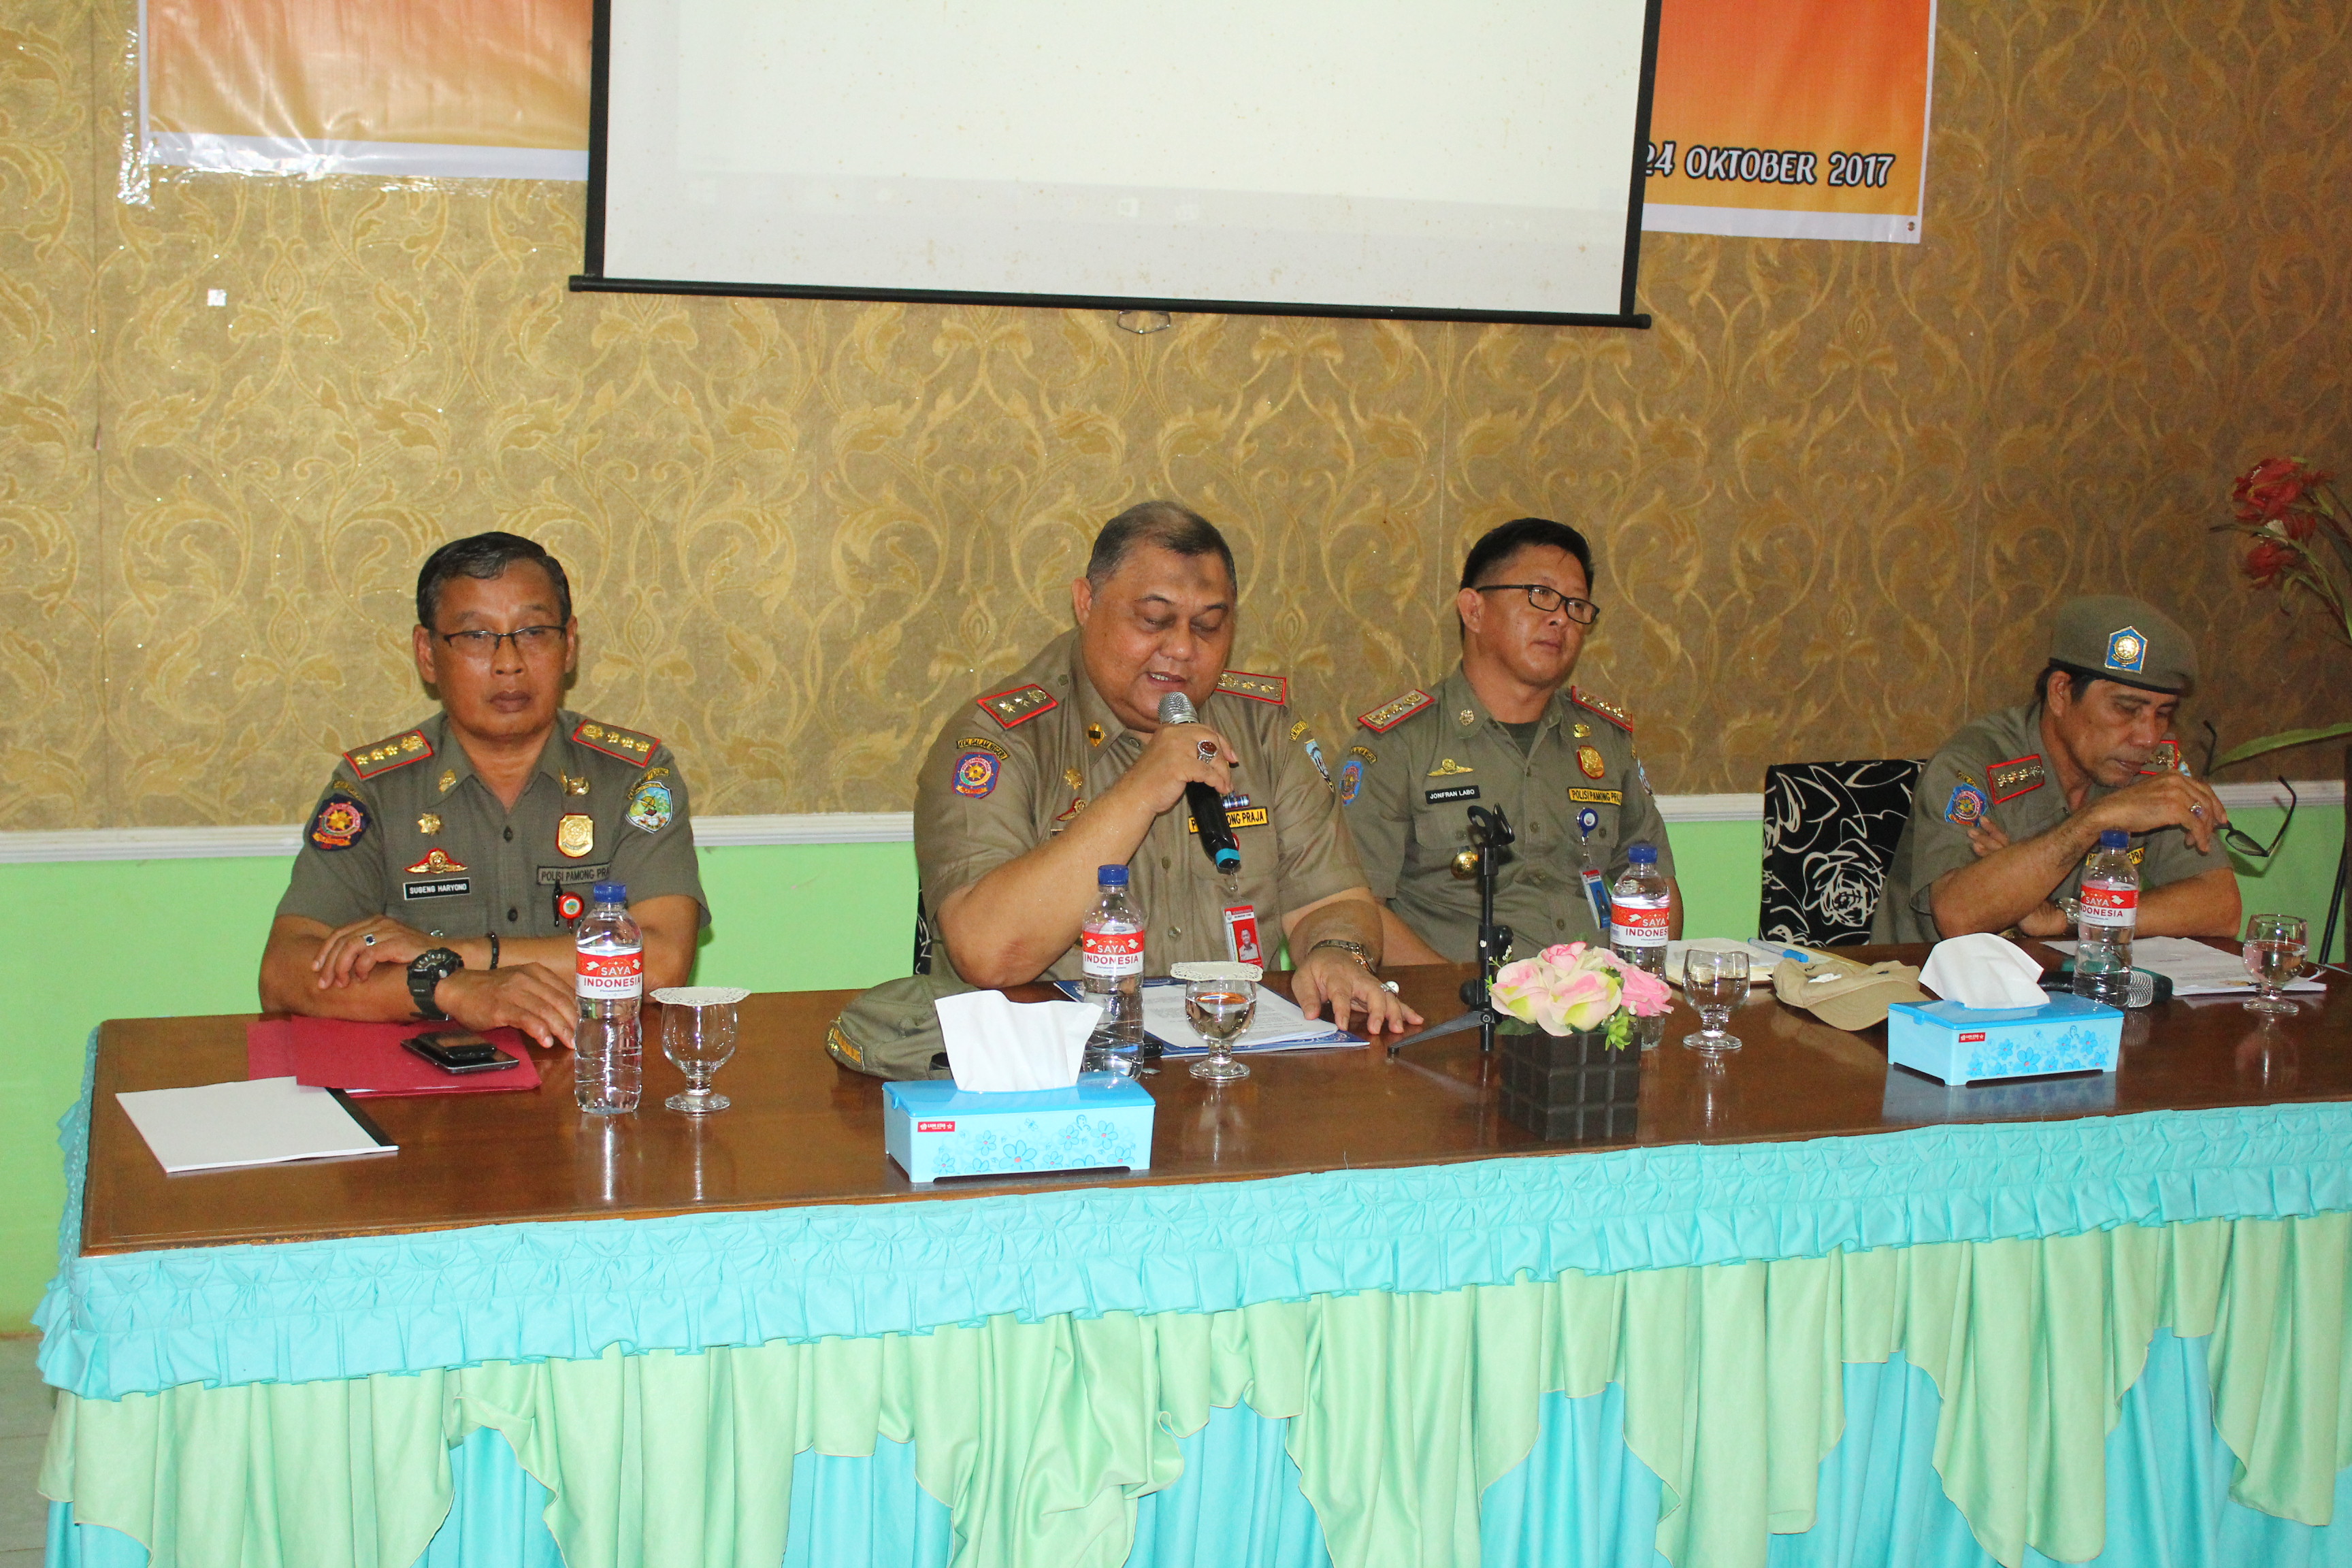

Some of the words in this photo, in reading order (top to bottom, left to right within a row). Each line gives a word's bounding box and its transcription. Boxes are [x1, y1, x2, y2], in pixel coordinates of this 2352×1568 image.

[1684, 145, 1818, 185] OKTOBER
[1827, 151, 1896, 188] 2017
[970, 738, 990, 748] DALAM
[989, 743, 1007, 759] NEGERI
[1430, 791, 1458, 800] JONFRAN
[1571, 789, 1590, 800] POLISI
[1590, 790, 1611, 801] PAMONG
[1242, 811, 1264, 823] PRAJA
[541, 870, 564, 881] POLISI
[566, 868, 595, 881] PAMONG
[410, 885, 436, 894] SUGENG
[438, 883, 468, 892] HARYONO
[2086, 896, 2110, 906] SAYA
[1642, 918, 1666, 926] SAYA
[1097, 945, 1126, 953] SAYA
[1084, 953, 1139, 965] INDONESIA
[601, 966, 632, 976] SAYA
[584, 975, 641, 987] INDONESIA
